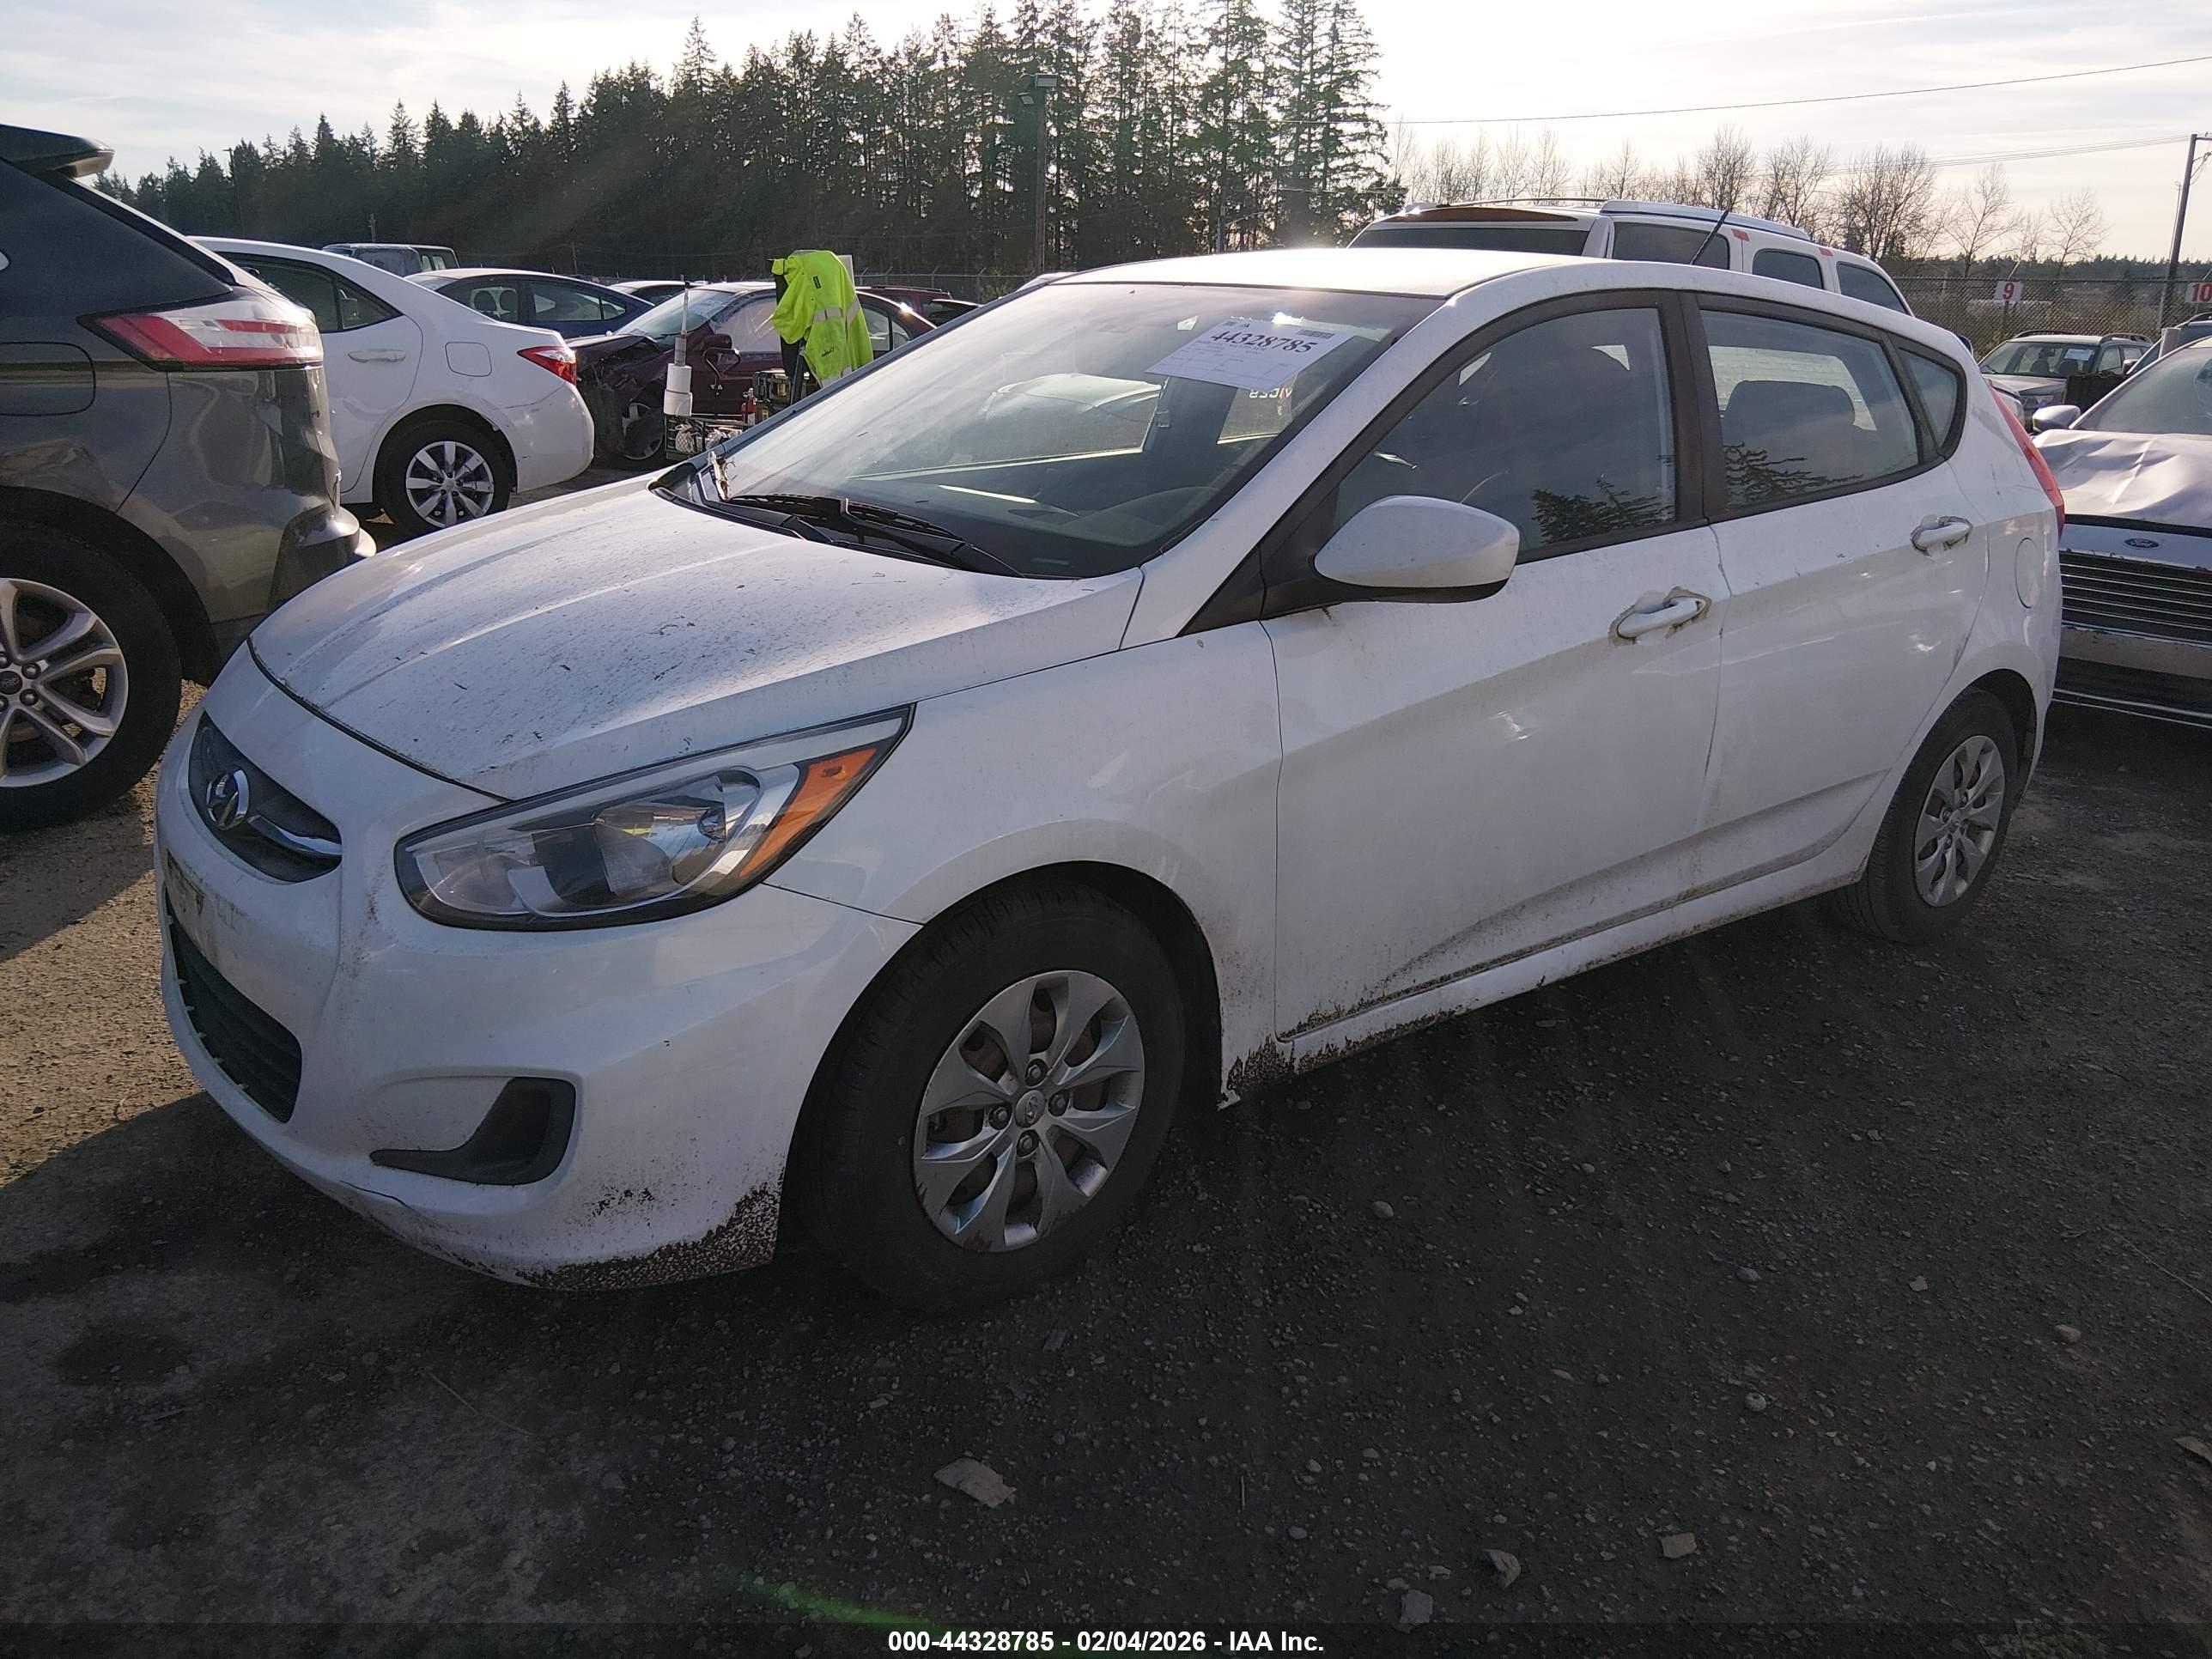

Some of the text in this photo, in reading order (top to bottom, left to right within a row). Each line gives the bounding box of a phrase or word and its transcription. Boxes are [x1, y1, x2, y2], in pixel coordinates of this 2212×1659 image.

[2002, 282, 2014, 300] 9
[2191, 283, 2212, 302] 10
[1211, 330, 1319, 354] 44328785
